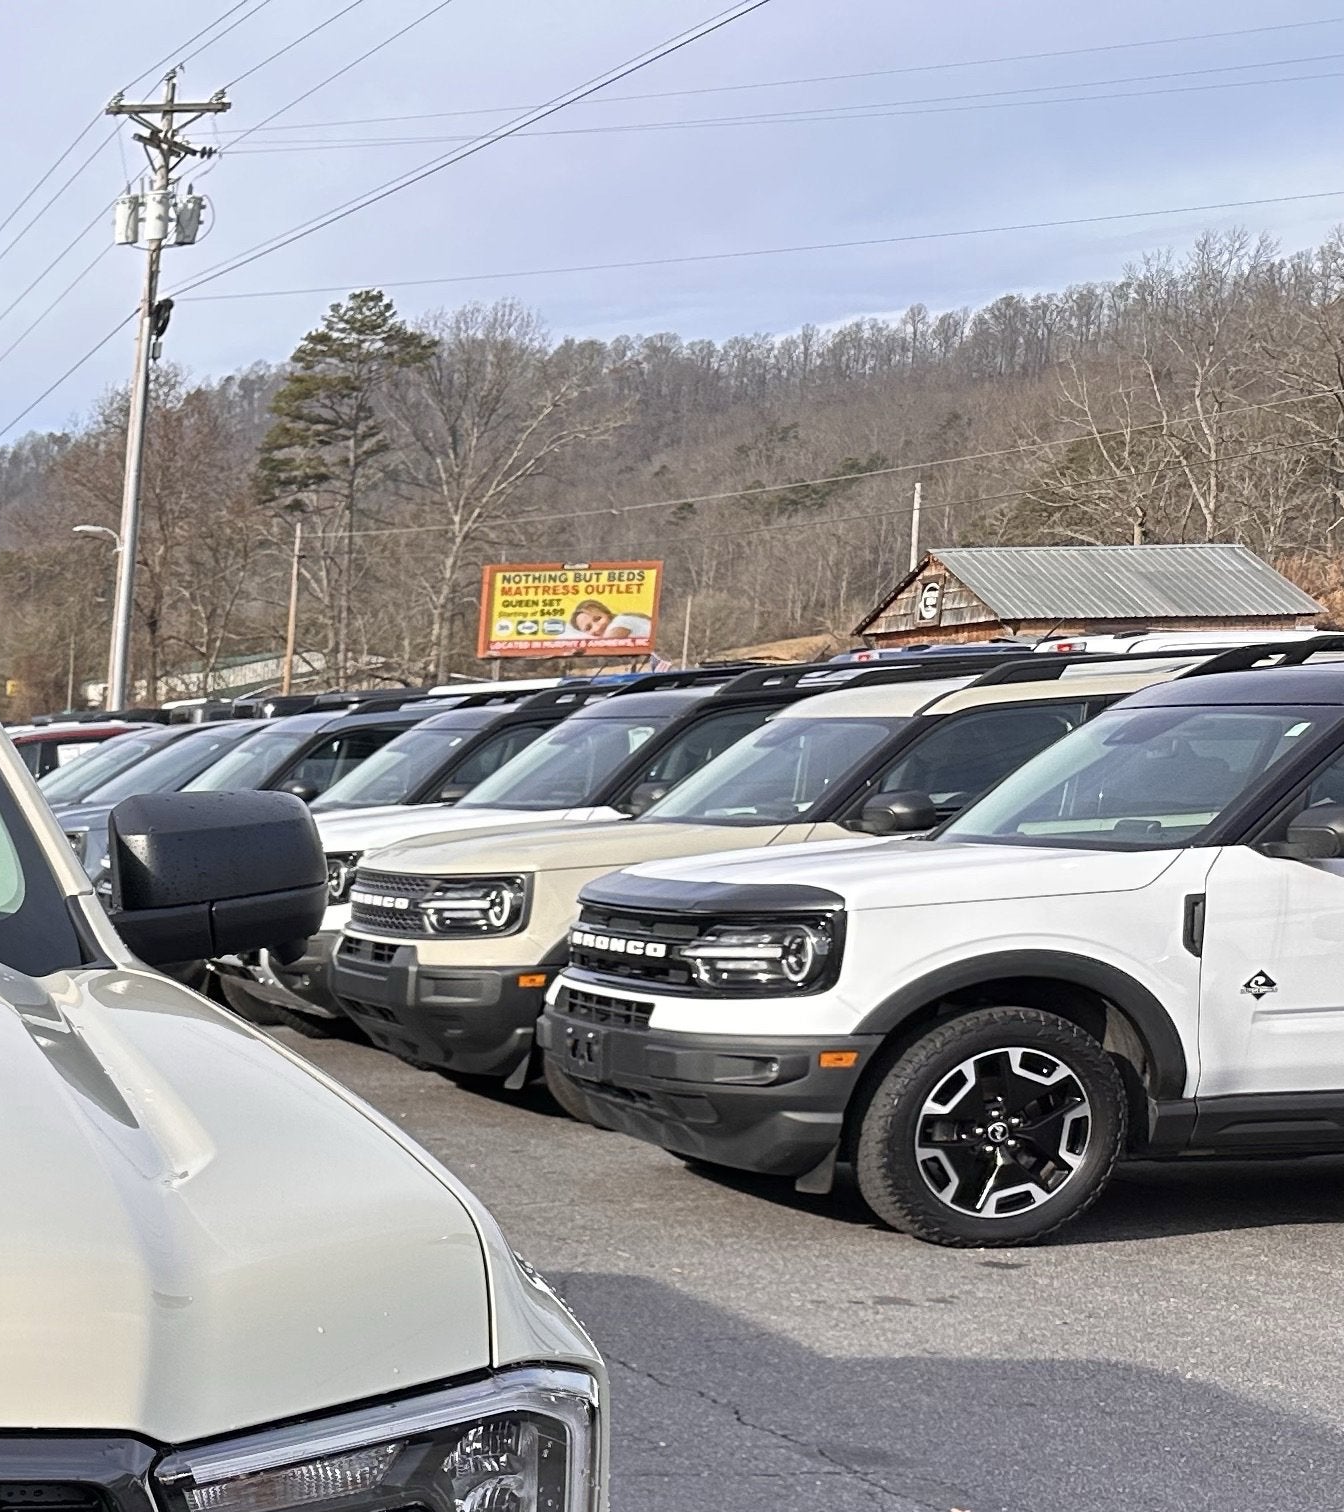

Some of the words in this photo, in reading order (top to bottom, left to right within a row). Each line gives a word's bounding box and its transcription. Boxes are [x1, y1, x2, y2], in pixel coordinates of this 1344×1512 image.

[501, 572, 568, 585] NOTHING
[573, 571, 602, 584] BUT
[607, 570, 645, 583] BEDS
[500, 584, 580, 597] MATTRESS
[584, 583, 644, 596] OUTLET
[501, 599, 539, 608] QUEEN
[542, 598, 562, 607] SET
[540, 608, 565, 617] $499
